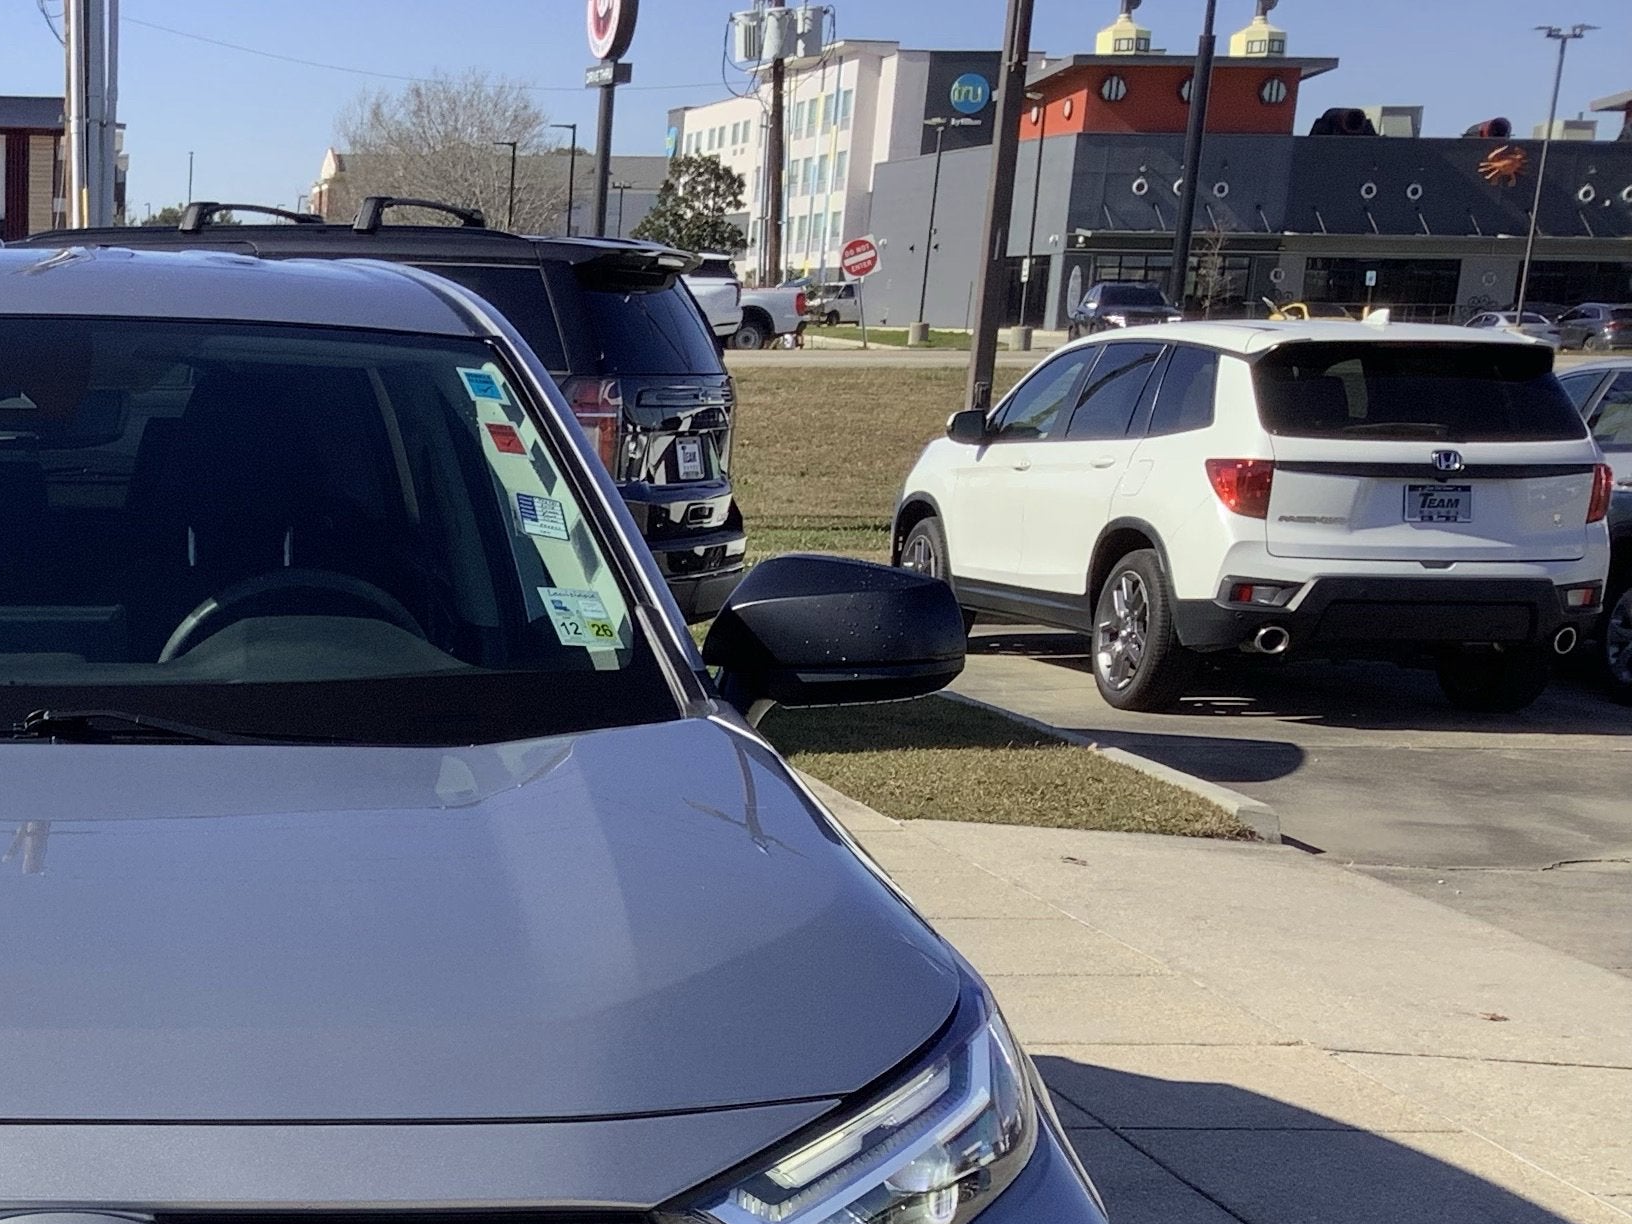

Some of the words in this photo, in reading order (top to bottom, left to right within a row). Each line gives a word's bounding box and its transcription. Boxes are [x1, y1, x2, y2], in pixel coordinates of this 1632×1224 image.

[844, 249, 855, 258] DO
[855, 243, 870, 254] NOT
[851, 259, 873, 273] ENTER
[1418, 492, 1460, 509] TEAM
[560, 621, 583, 636] 12
[590, 623, 614, 638] 26
